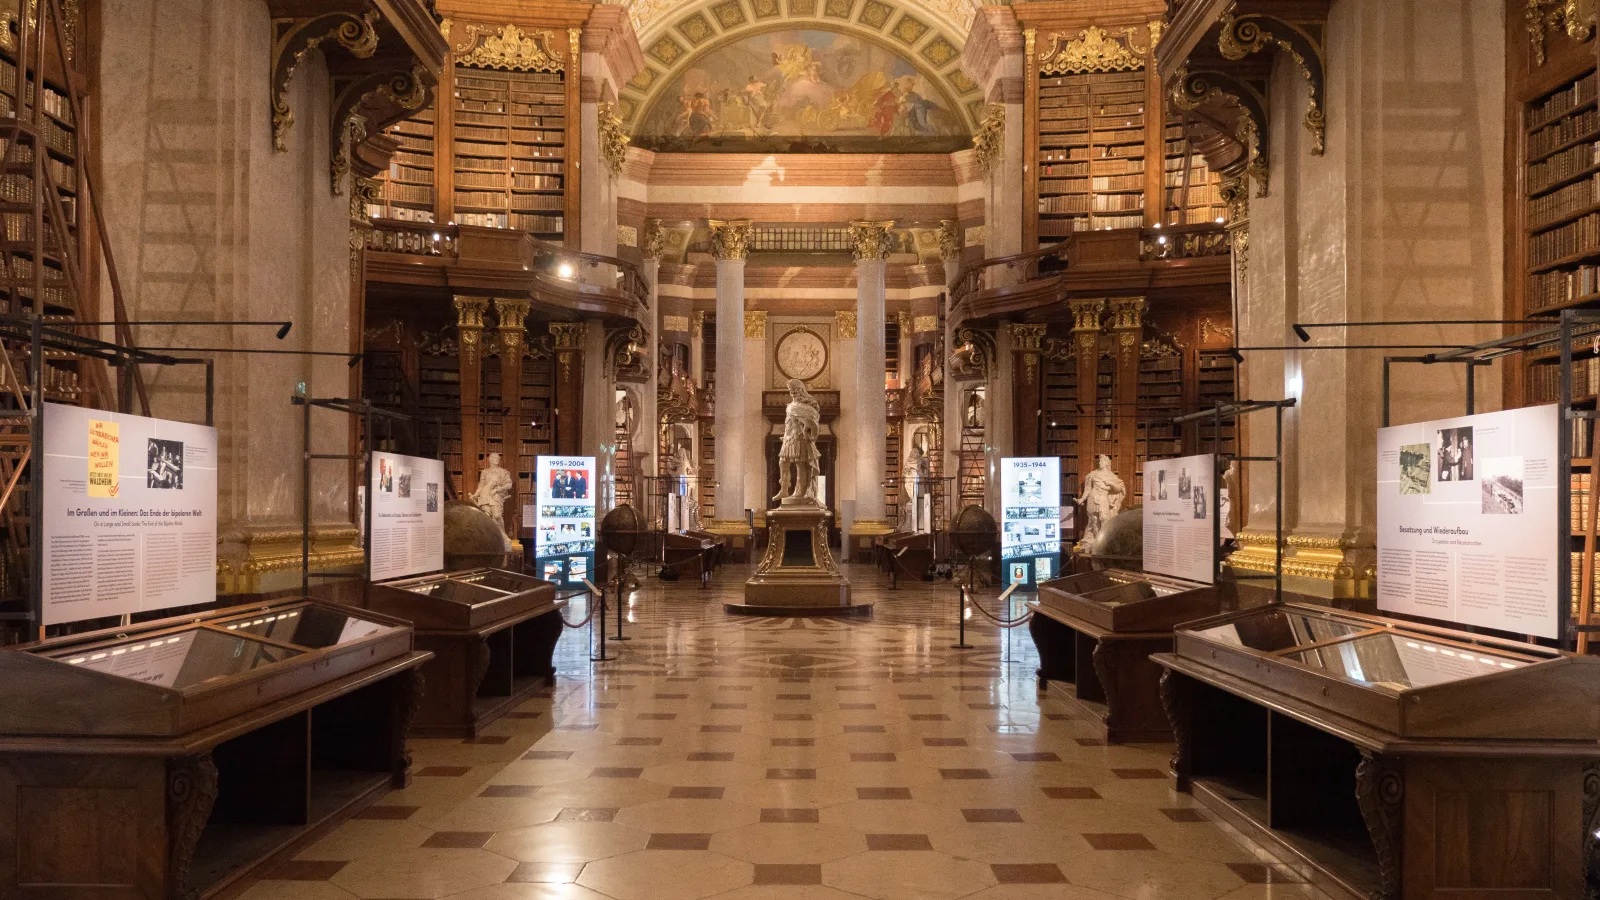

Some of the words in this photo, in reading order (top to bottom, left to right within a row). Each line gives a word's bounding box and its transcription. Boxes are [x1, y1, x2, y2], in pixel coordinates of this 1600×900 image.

[67, 508, 75, 517] Im
[76, 508, 98, 517] Großen
[98, 508, 110, 517] und
[110, 508, 118, 517] im
[140, 509, 149, 517] Das
[150, 509, 162, 517] Ende
[162, 509, 170, 517] der
[170, 510, 192, 519] bipolaren
[192, 509, 202, 517] Welt
[1399, 525, 1422, 536] Besatzung
[1423, 526, 1432, 534] und
[1433, 526, 1469, 535] Wiederaufbau
